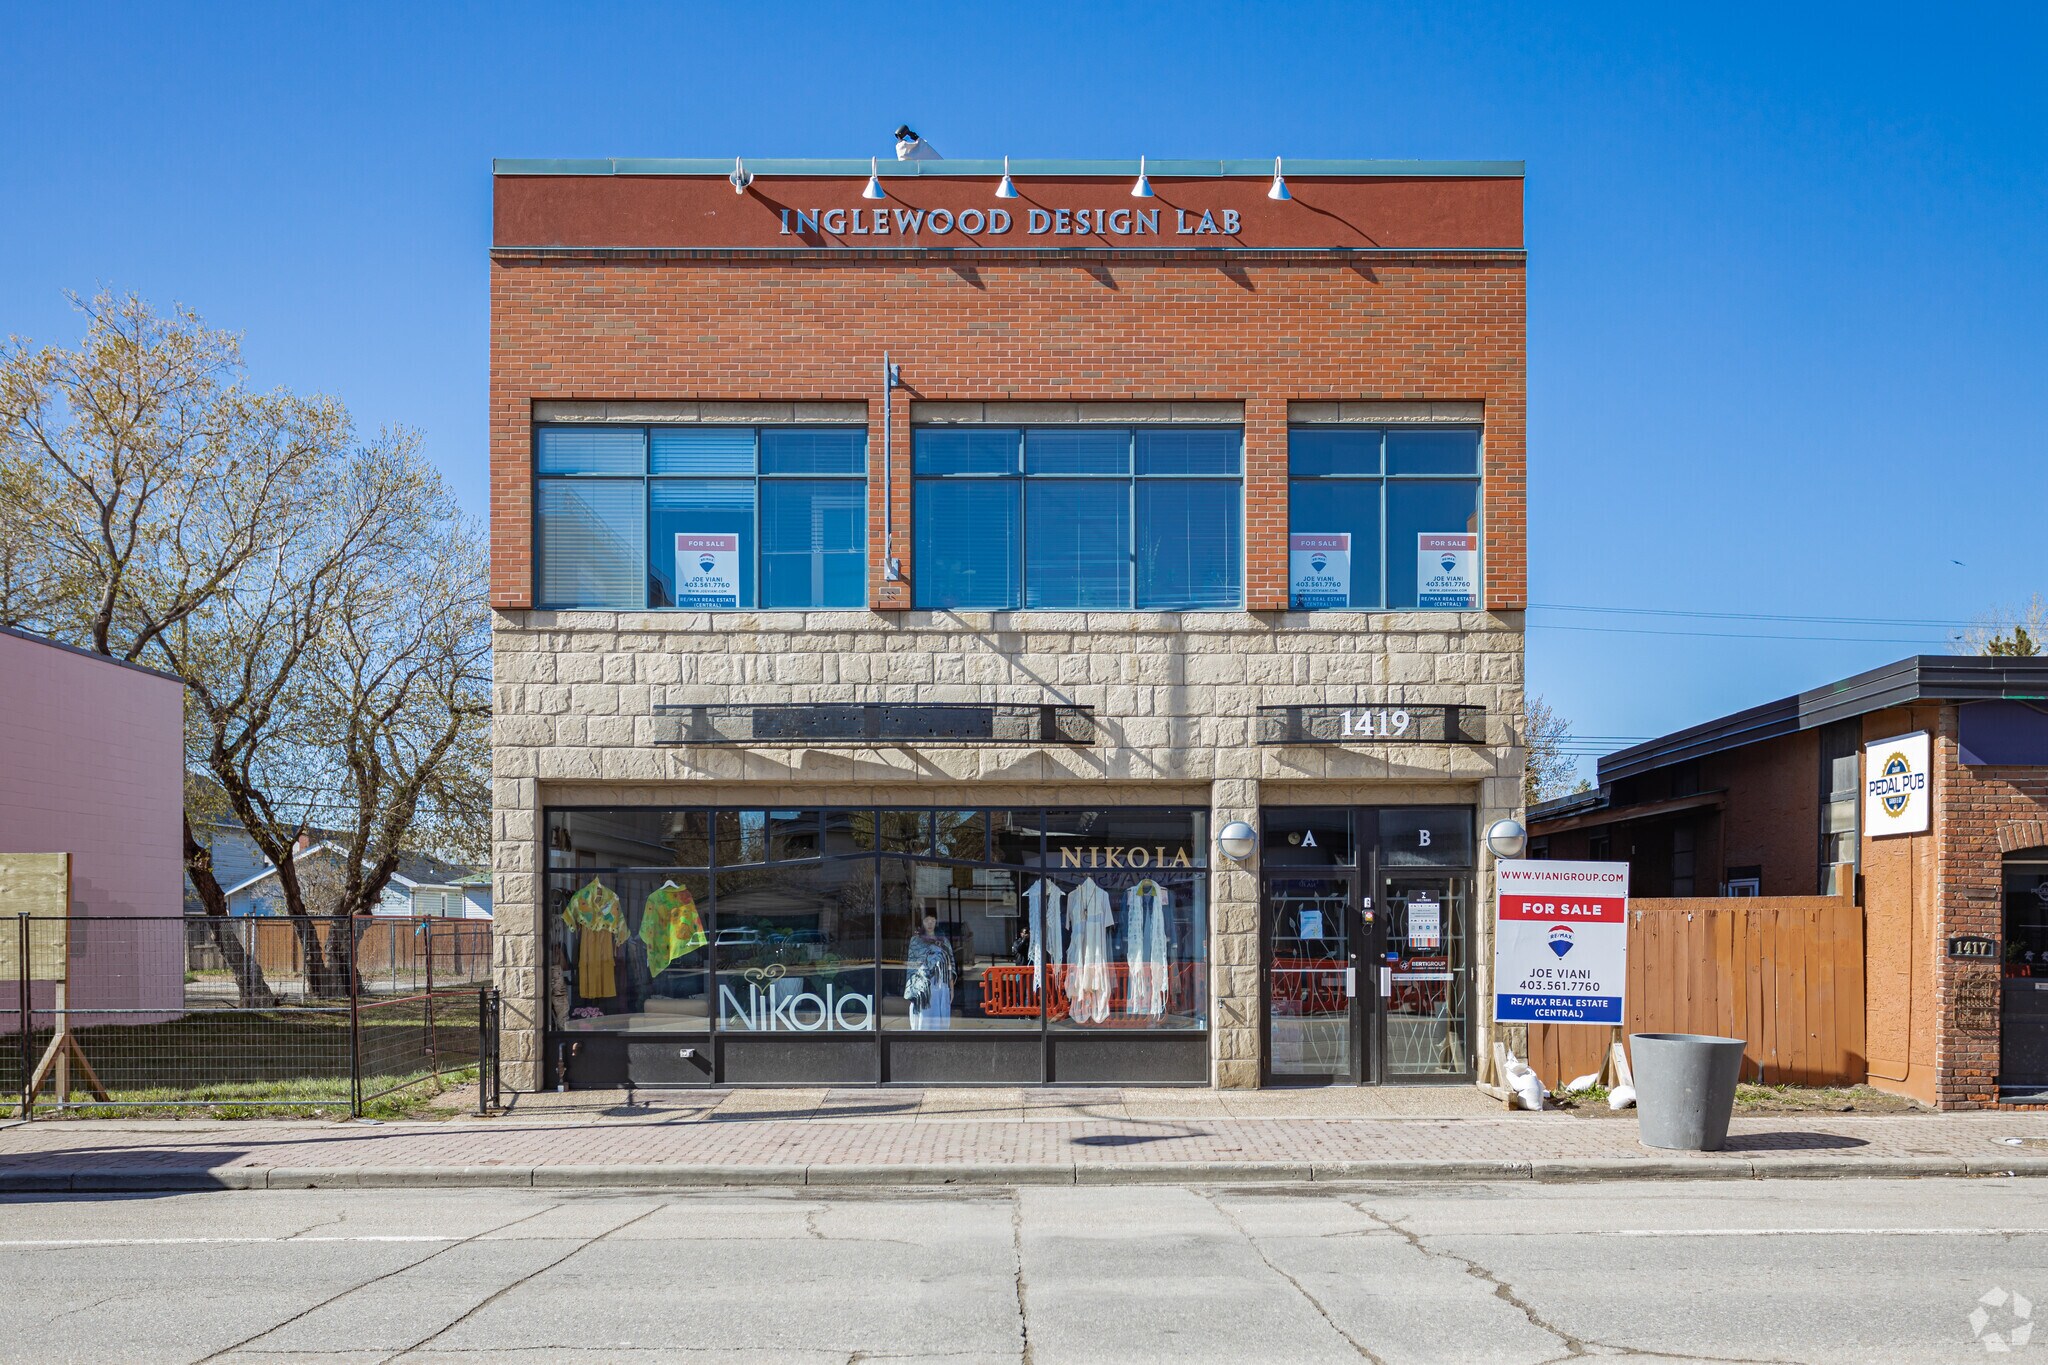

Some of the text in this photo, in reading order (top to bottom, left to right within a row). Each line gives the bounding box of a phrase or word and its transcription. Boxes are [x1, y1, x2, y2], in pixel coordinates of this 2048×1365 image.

[780, 208, 1241, 235] INGLEWOOD DESIGN LAB
[1340, 710, 1409, 736] 1419
[1869, 773, 1924, 796] PEDAL PUB
[1301, 830, 1317, 847] A
[1419, 829, 1431, 846] B
[1060, 846, 1192, 868] NIKOLA
[1501, 871, 1624, 882] WWW.VIANIGROUP.COM
[1522, 902, 1602, 915] FOR SALE
[1957, 941, 1987, 956] 1417
[1530, 968, 1591, 979] JOE VIANI
[1520, 980, 1600, 992] 403.561.7760
[719, 983, 873, 1031] Nikola
[1511, 997, 1608, 1007] RE/MAX REAL ESTATE
[1535, 1009, 1583, 1018] (CENTRAL)
